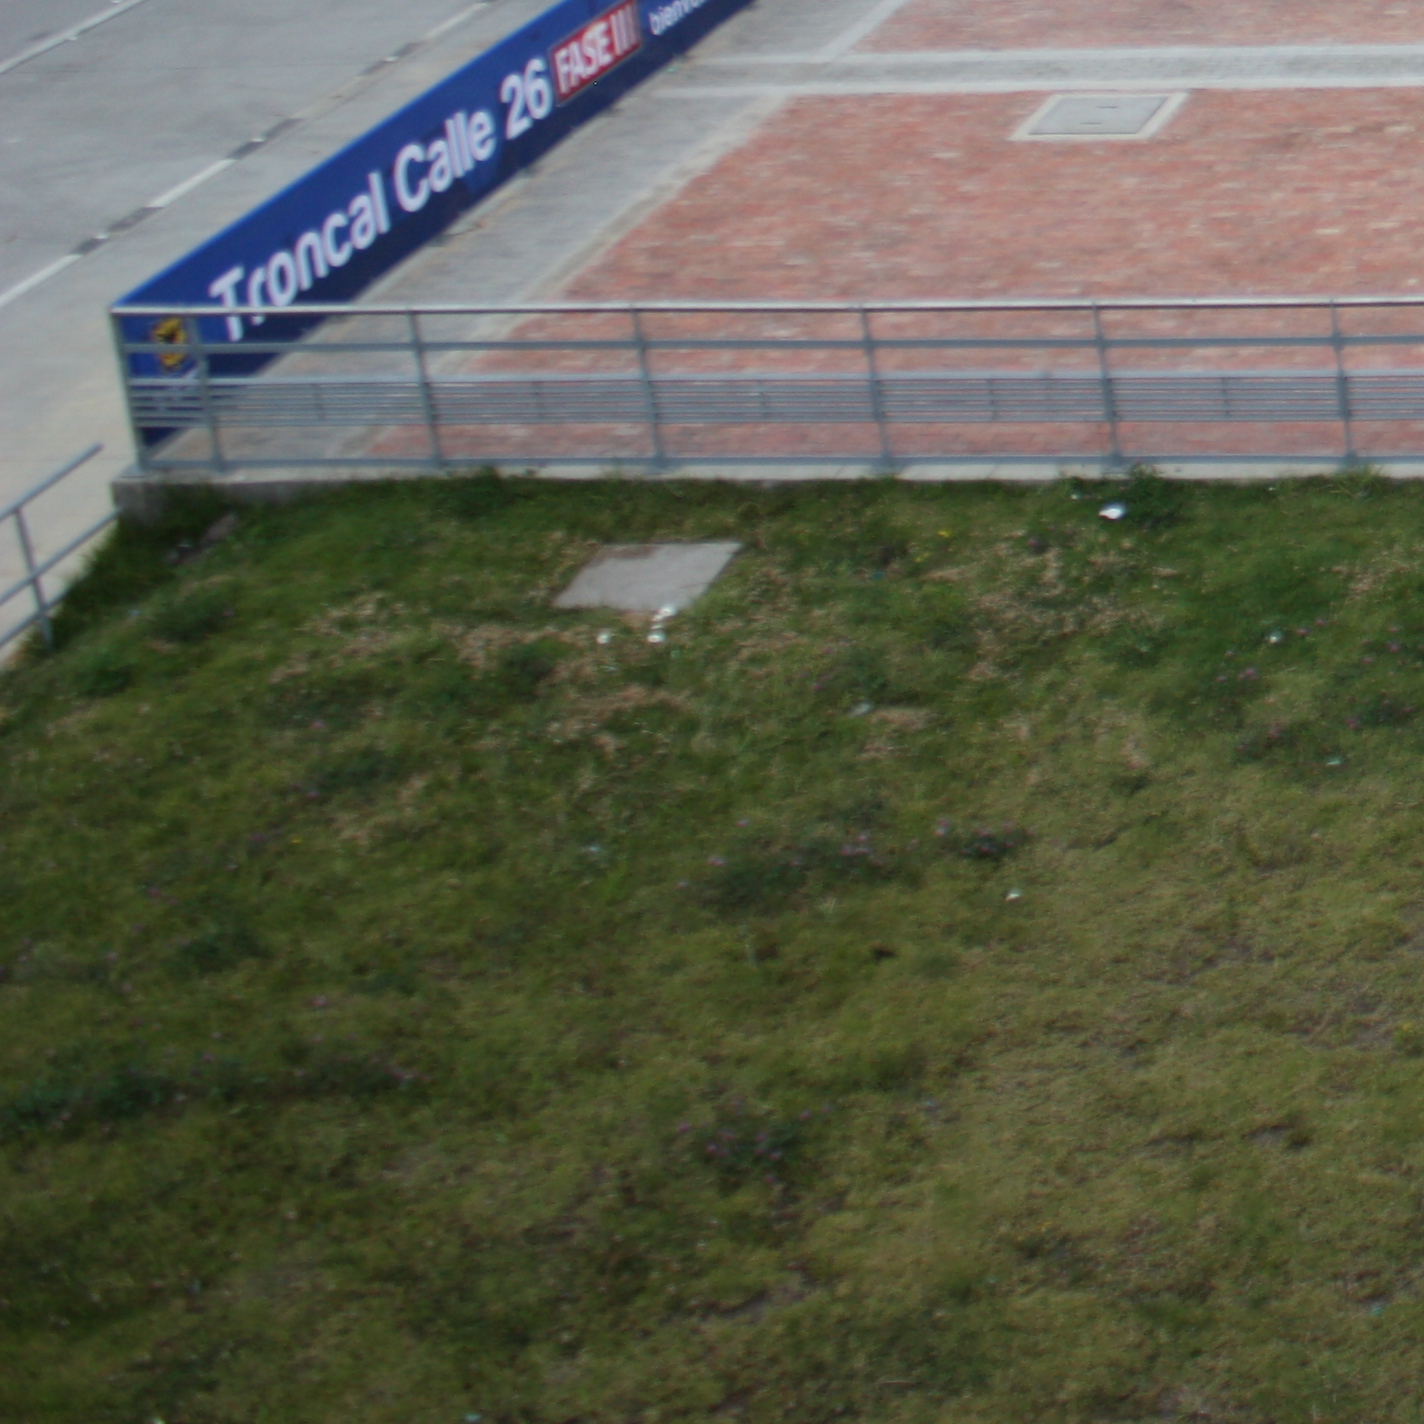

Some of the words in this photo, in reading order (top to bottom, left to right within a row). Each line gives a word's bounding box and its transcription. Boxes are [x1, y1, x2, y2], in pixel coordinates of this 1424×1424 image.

[208, 170, 391, 343] Troncal
[394, 110, 497, 213] Calle
[500, 57, 552, 141] 26
[554, 21, 615, 95] FASE
[610, 5, 639, 56] III
